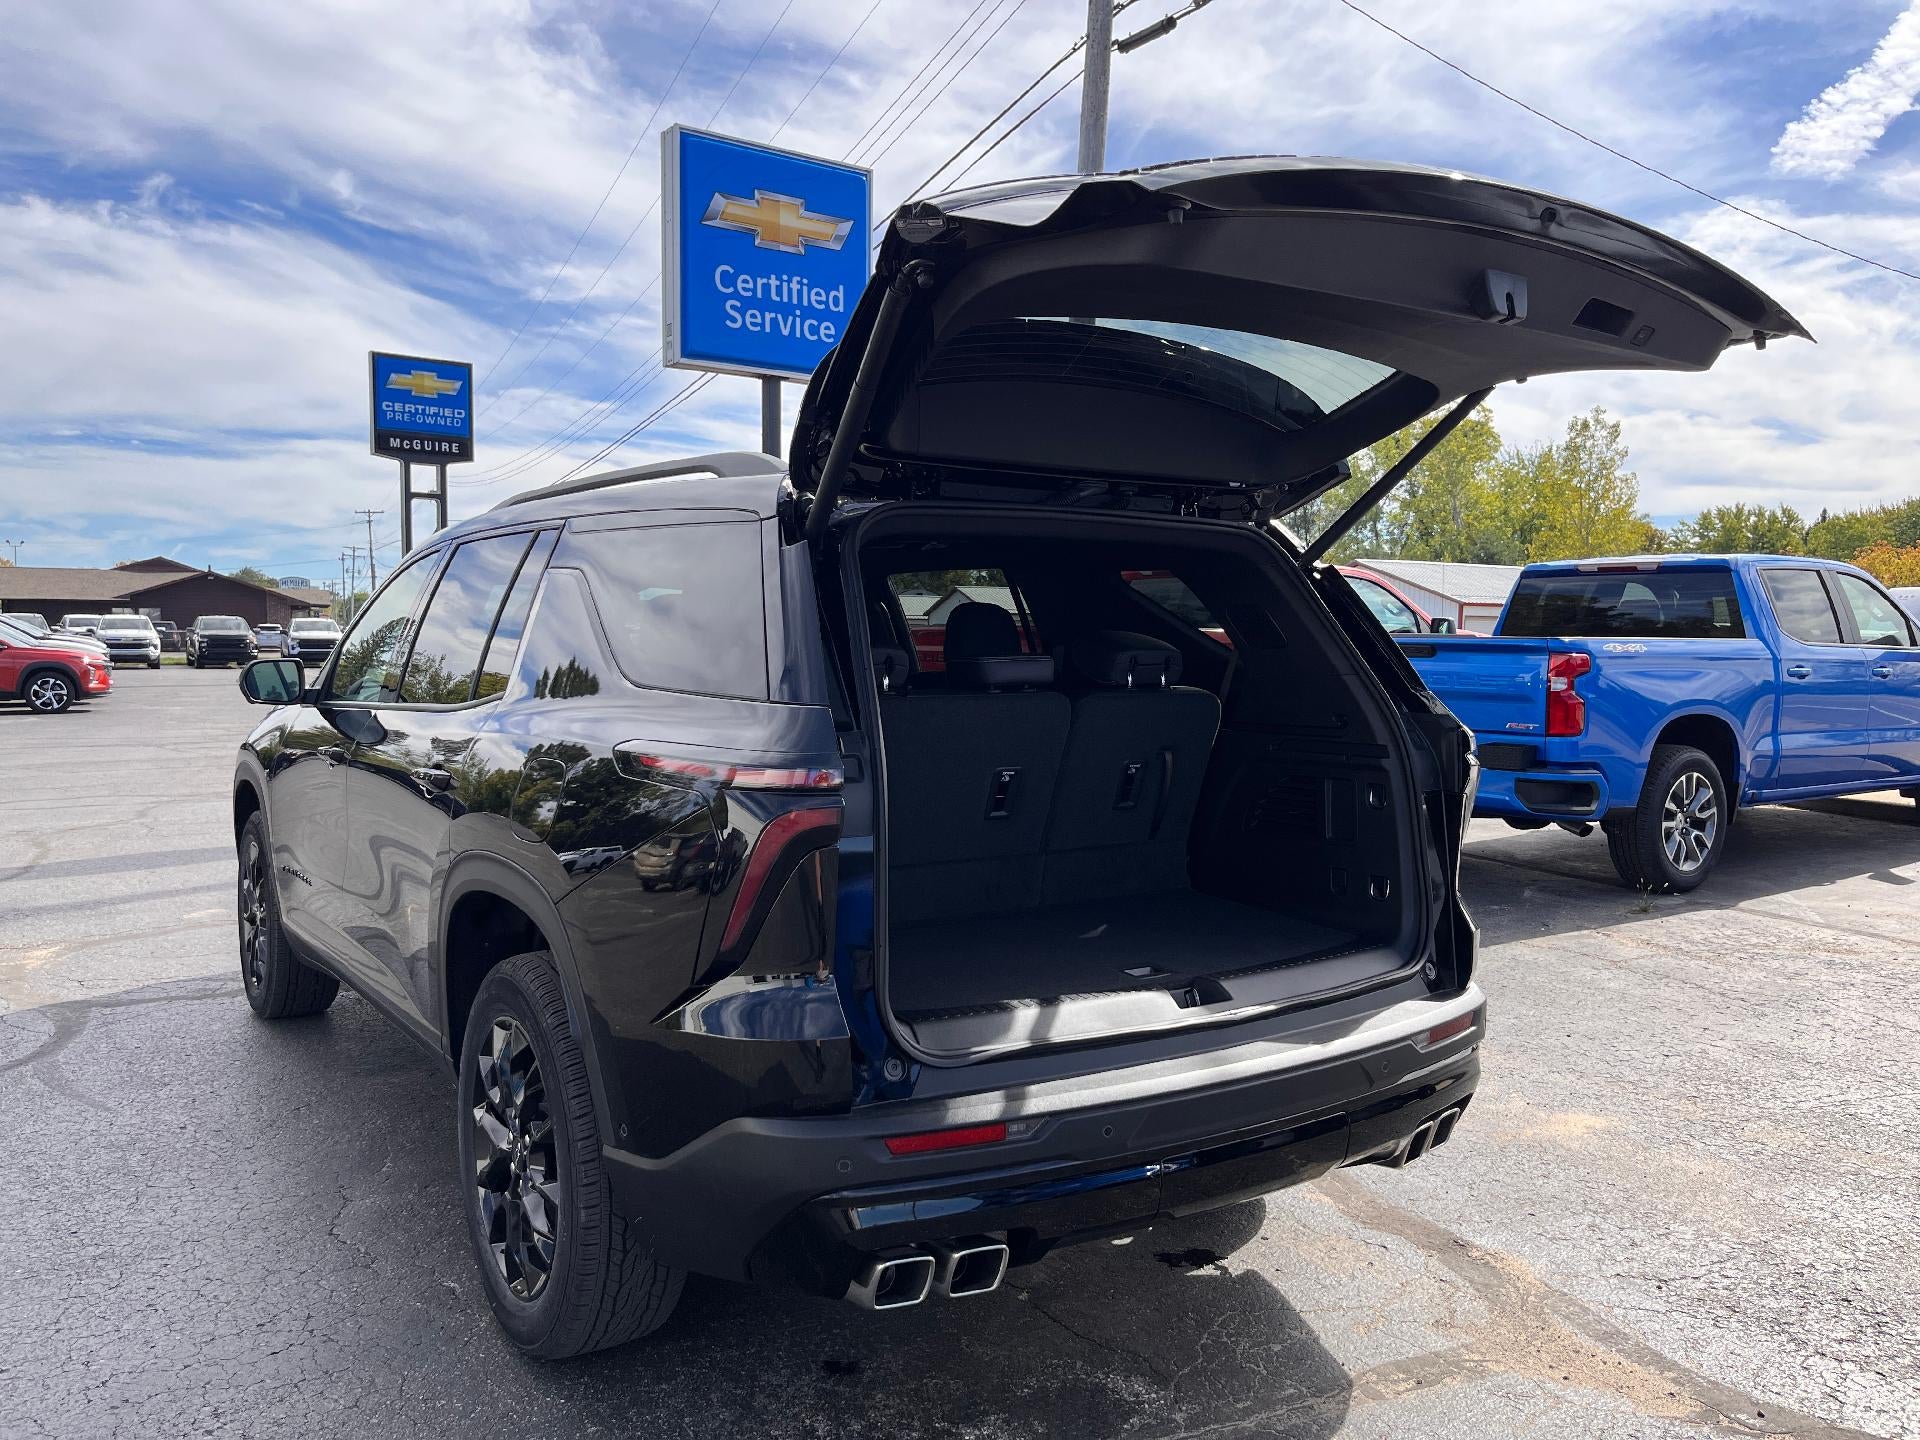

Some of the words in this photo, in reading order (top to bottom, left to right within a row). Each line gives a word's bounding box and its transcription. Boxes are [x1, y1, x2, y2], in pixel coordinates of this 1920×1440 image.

[714, 264, 844, 313] Certified
[725, 300, 836, 343] Service
[382, 401, 465, 418] CERTIFIED
[386, 411, 462, 427] PRE-OWNED
[389, 437, 460, 453] McGUIRE
